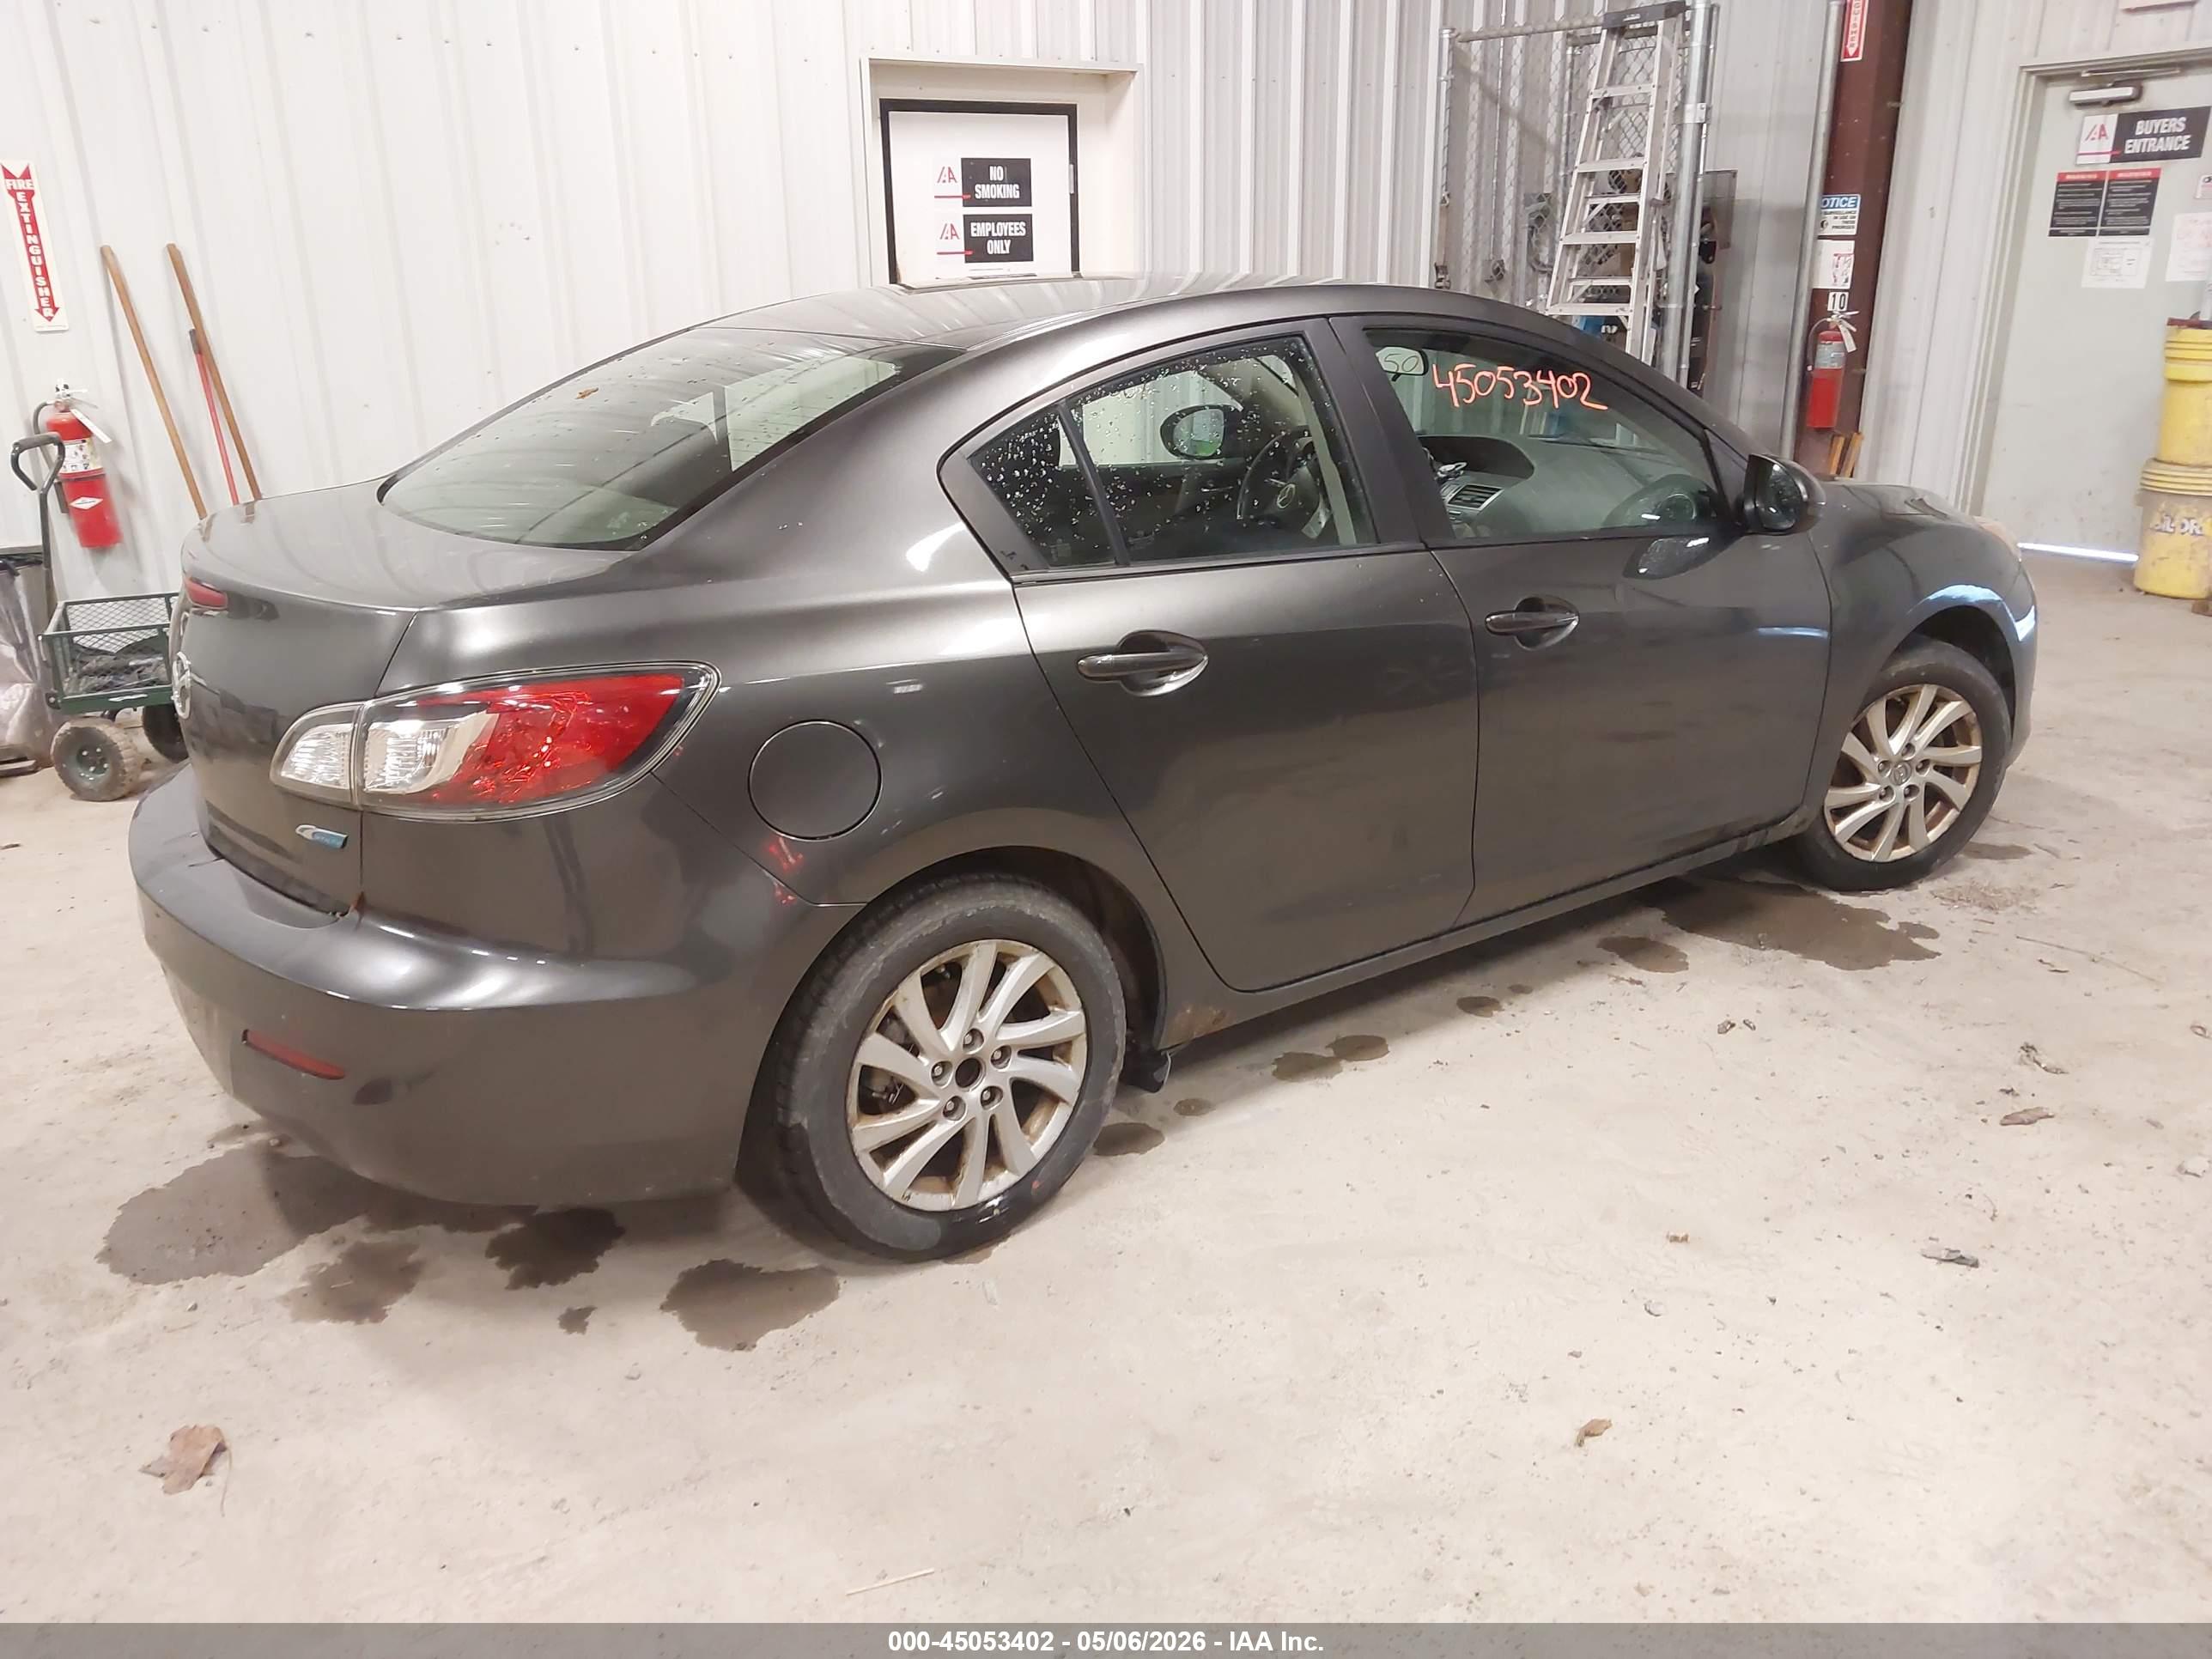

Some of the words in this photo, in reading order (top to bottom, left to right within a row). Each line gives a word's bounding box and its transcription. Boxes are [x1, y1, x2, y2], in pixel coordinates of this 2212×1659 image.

[2135, 117, 2187, 136] BUYERS
[2124, 135, 2191, 154] ENTRANCE
[989, 166, 1004, 181] NO
[4, 179, 34, 191] FIRE
[975, 184, 1020, 198] SMOKING
[1821, 197, 1857, 208] OTICE
[970, 222, 1026, 237] EMPLOYEES
[15, 191, 55, 318] EXTINGUISHER
[987, 240, 1012, 254] ONLY
[1830, 293, 1846, 310] 10
[1432, 363, 1608, 409] 45053402
